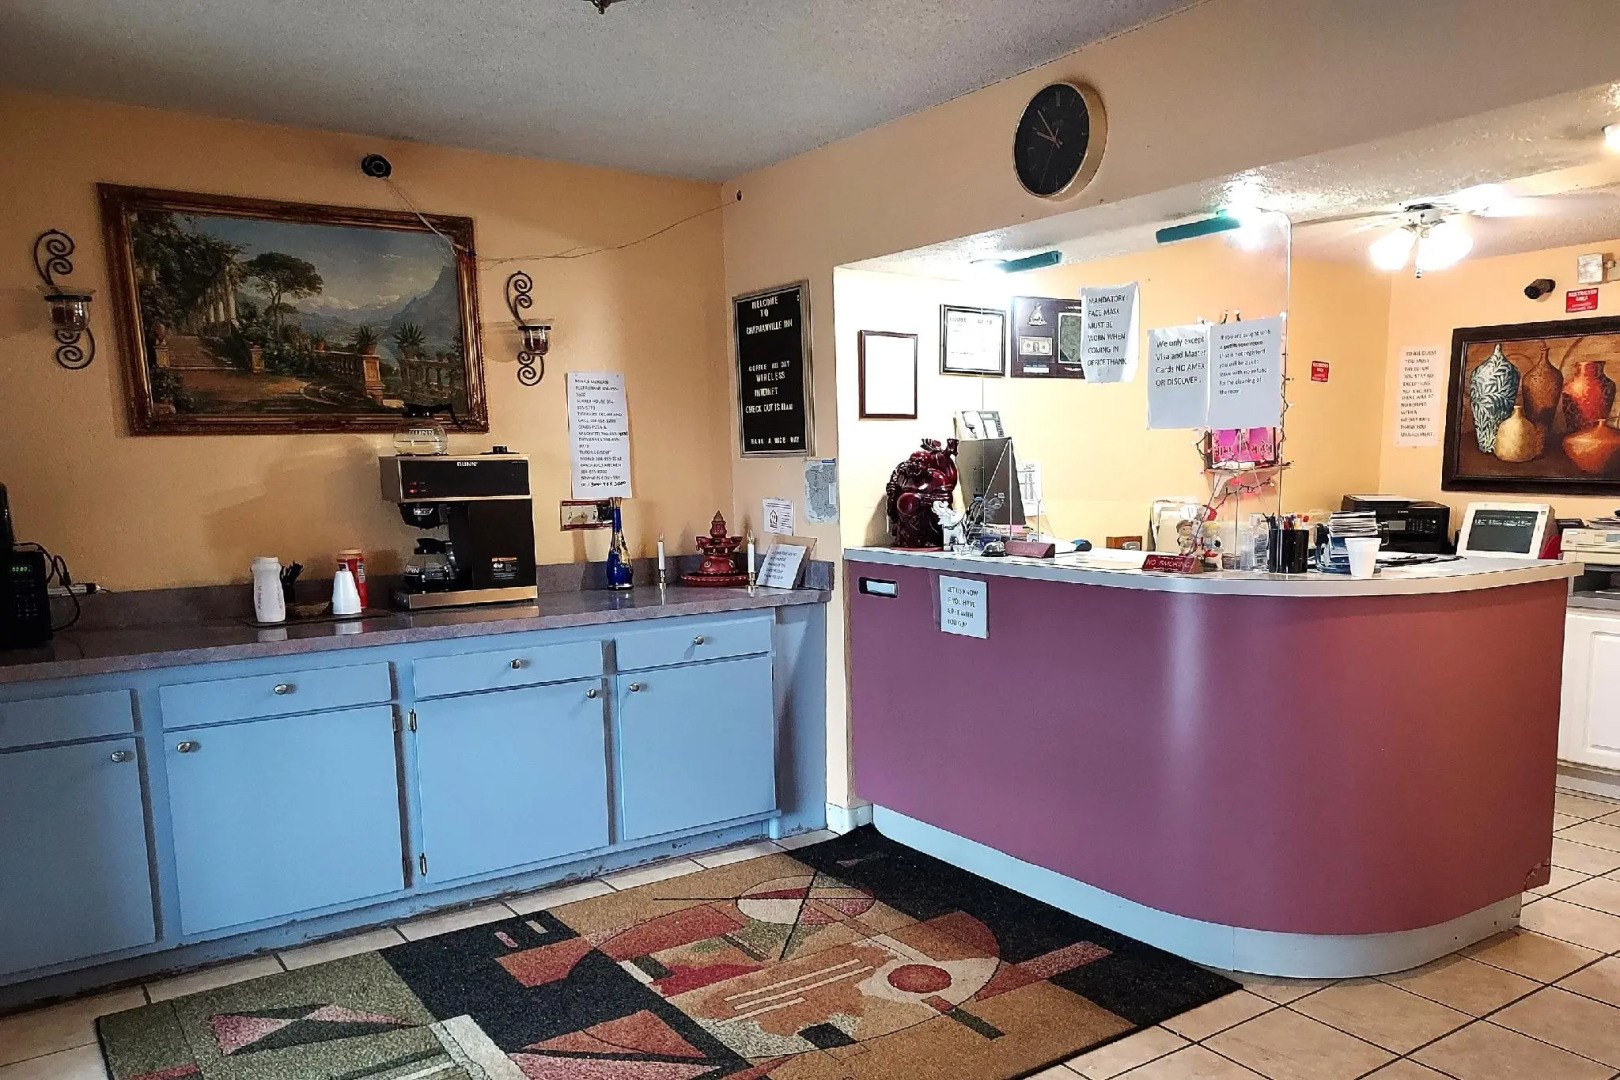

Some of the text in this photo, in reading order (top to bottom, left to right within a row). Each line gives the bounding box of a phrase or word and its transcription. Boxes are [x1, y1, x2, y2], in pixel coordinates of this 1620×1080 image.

[751, 296, 778, 310] WELCOME
[1088, 294, 1126, 305] MANDATORY
[760, 308, 769, 317] TO
[1087, 307, 1120, 317] FACE MASK
[783, 318, 793, 329] INN
[1087, 320, 1113, 330] MUST BE
[1087, 332, 1126, 342] WORN WHEN
[1156, 336, 1205, 348] We only except
[1087, 345, 1120, 355] COMING IN
[1155, 350, 1206, 361] Visa and Master
[1087, 357, 1127, 367] OFFICE THANK
[748, 363, 767, 372] COFFEE
[1155, 362, 1206, 374] Cards NO AMEX
[756, 371, 786, 382] WIRELESS
[1155, 378, 1166, 387] OR
[754, 386, 778, 397] INTERNET
[745, 404, 762, 414] CHECK
[763, 403, 773, 412] OUT
[774, 403, 781, 411] IS
[1146, 558, 1157, 566] NO
